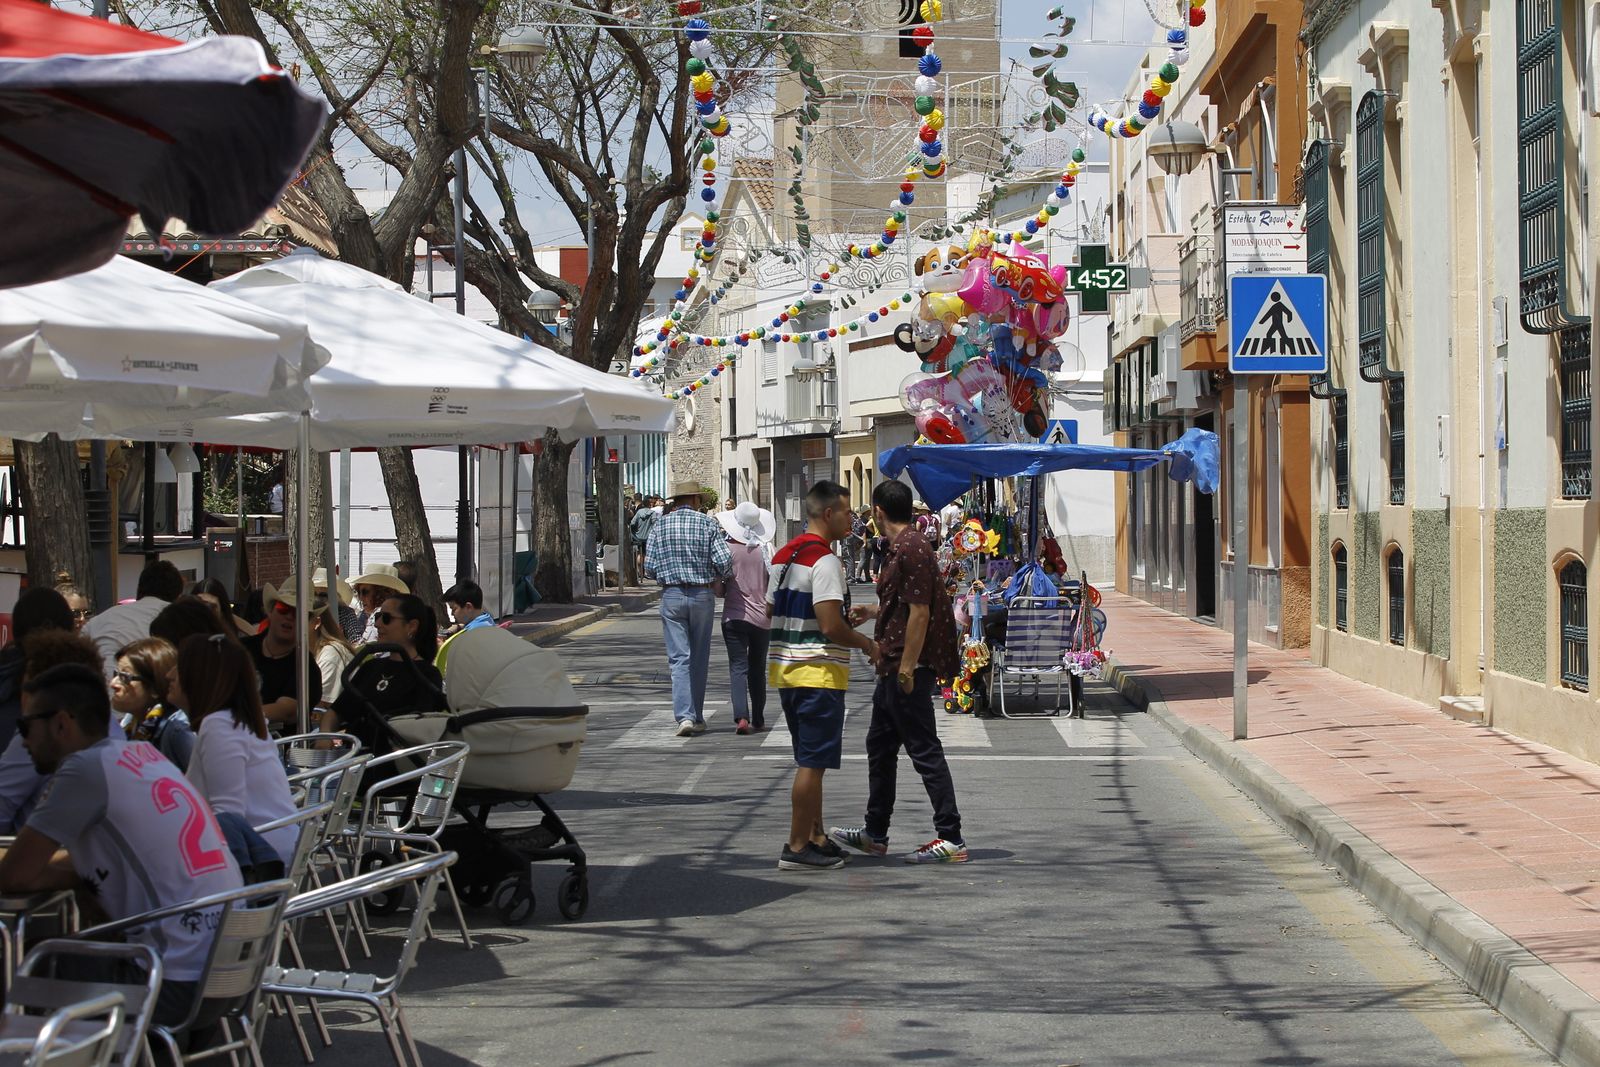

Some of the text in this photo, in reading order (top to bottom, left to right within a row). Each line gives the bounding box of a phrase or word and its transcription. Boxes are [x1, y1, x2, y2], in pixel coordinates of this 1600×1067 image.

[1259, 210, 1286, 226] Raquel
[1231, 238, 1253, 247] MODAS
[1065, 269, 1126, 289] 14:52
[152, 777, 228, 877] 2
